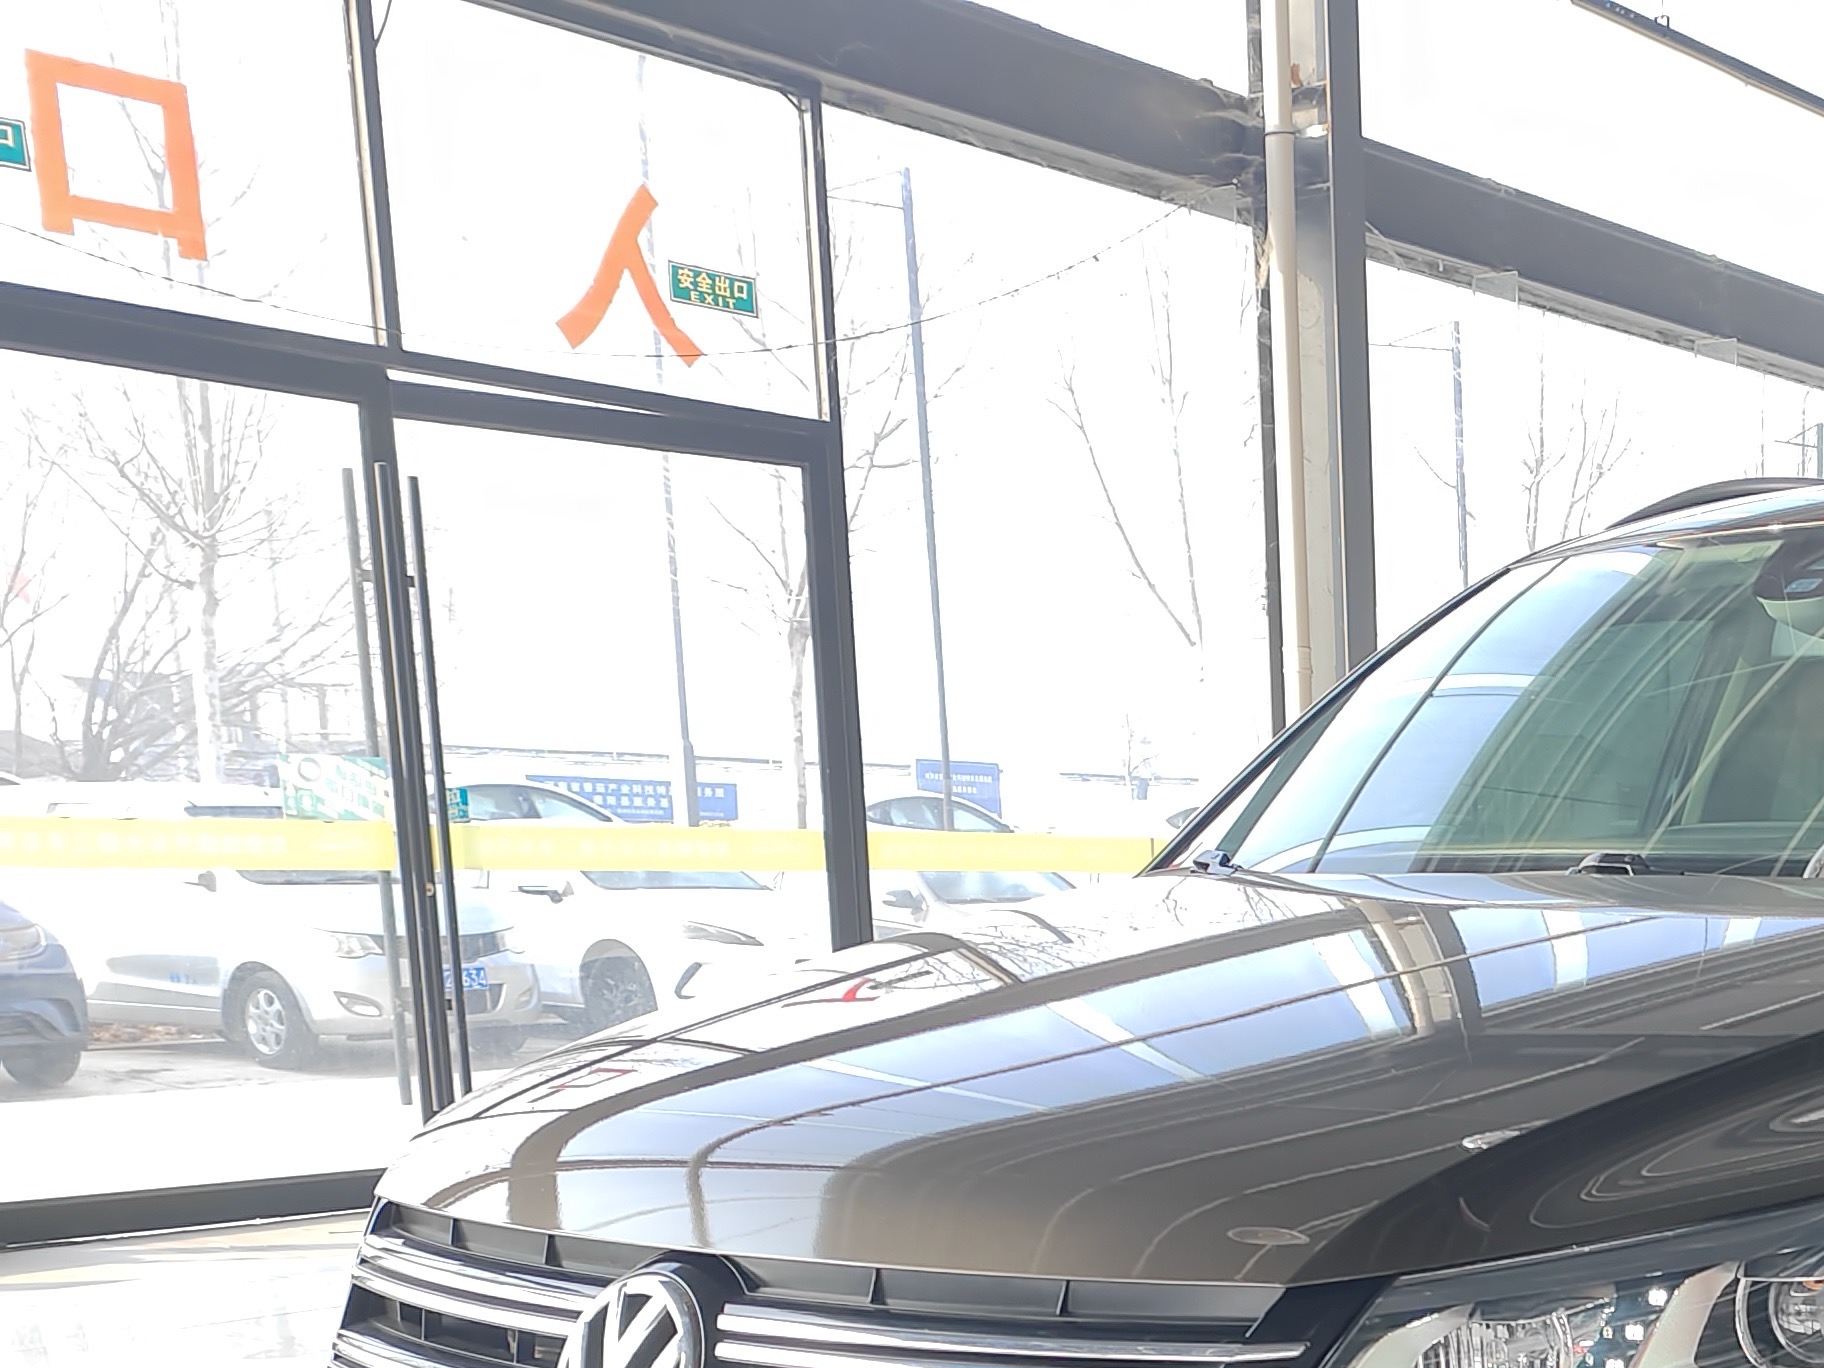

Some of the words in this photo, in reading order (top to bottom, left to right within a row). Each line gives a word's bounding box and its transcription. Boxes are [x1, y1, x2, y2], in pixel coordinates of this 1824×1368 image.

[677, 268, 748, 300] 安全出口
[690, 290, 736, 309] EXIT
